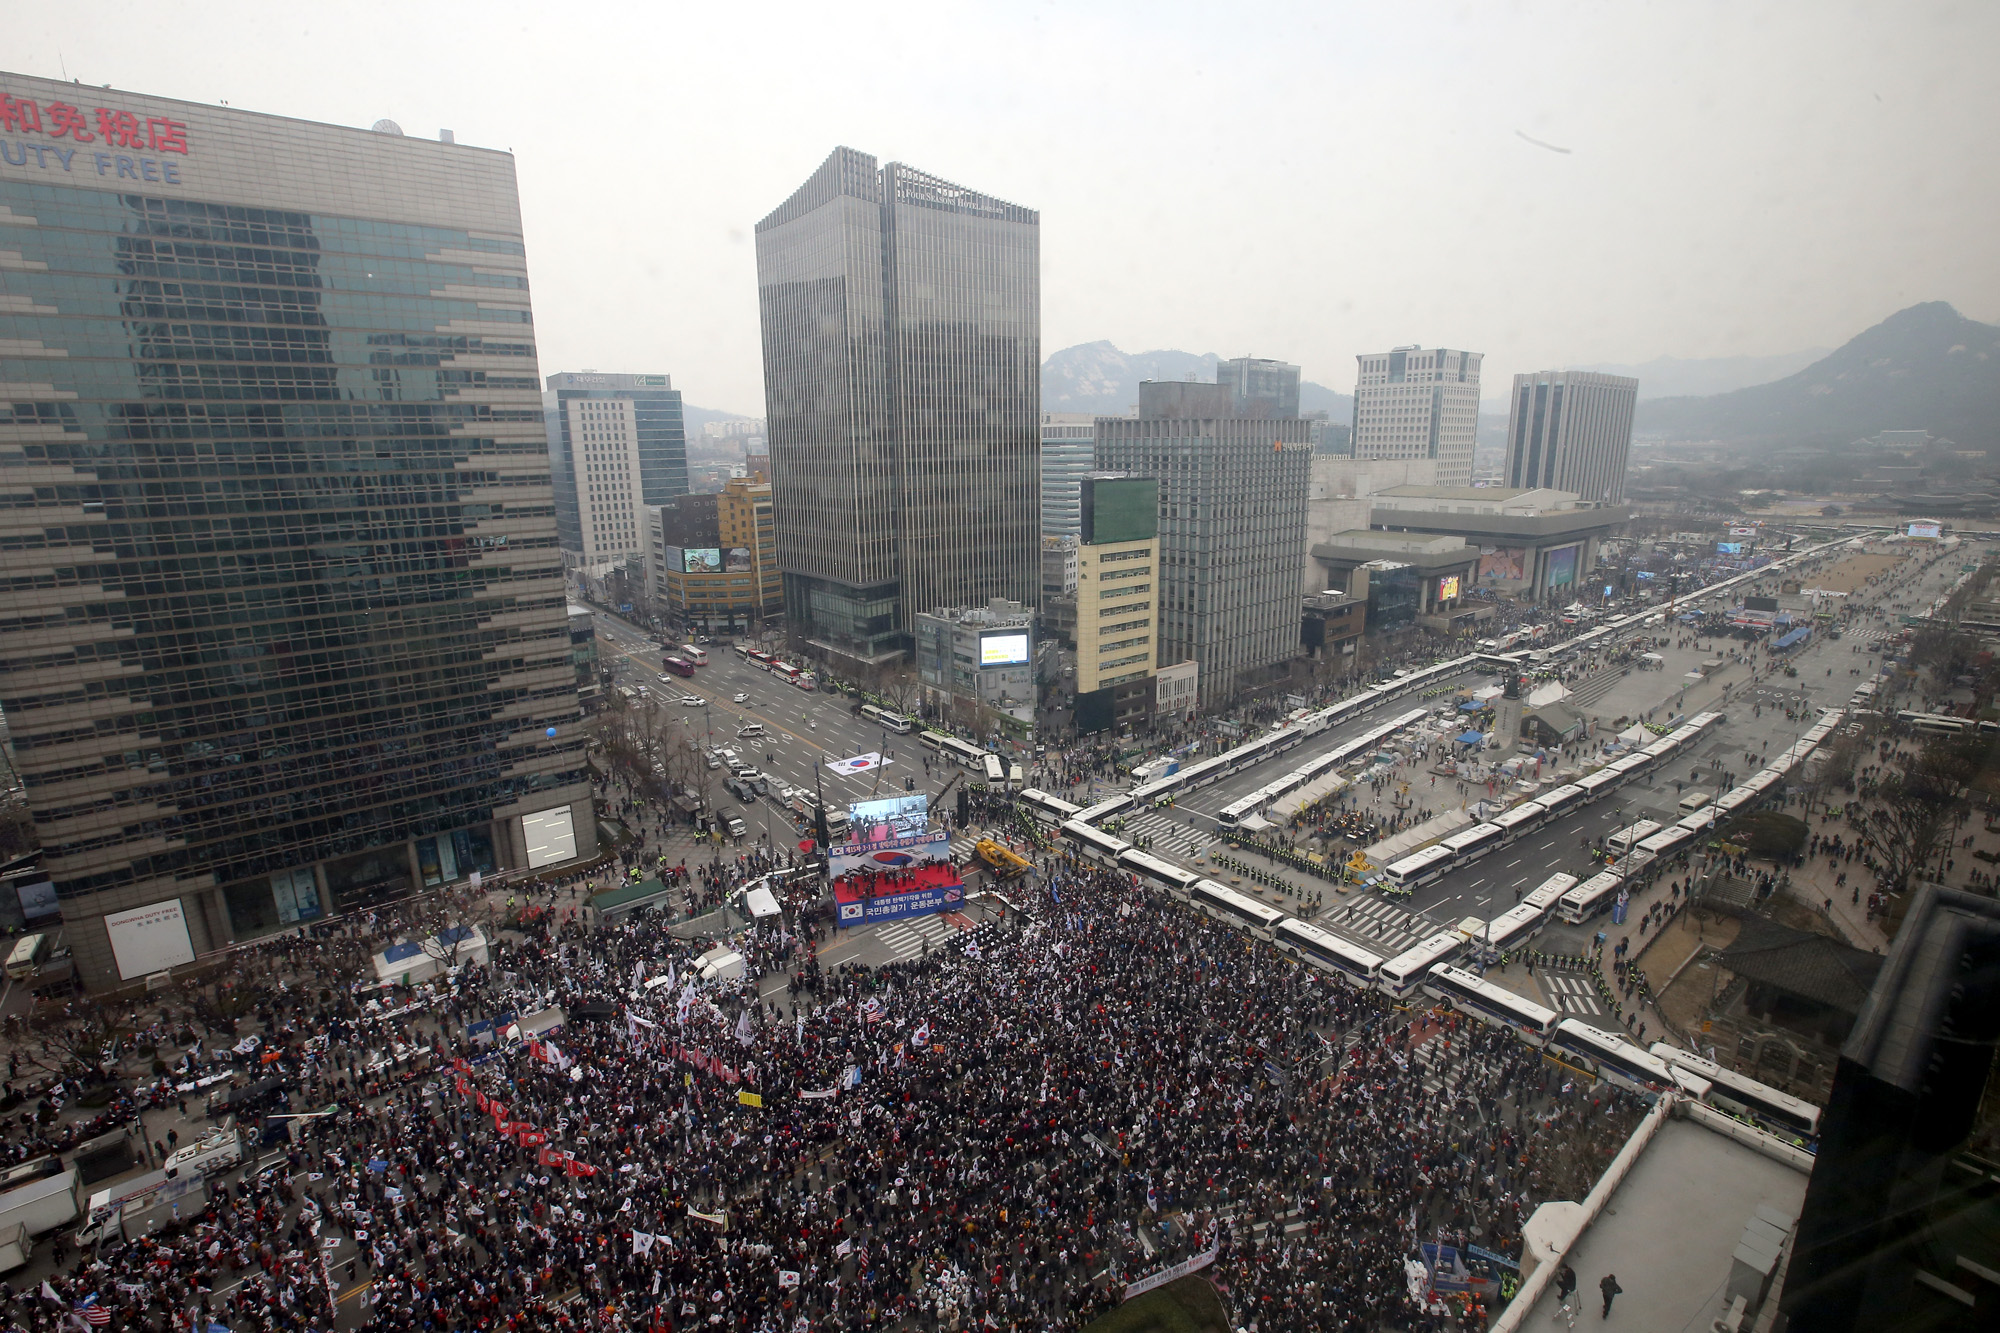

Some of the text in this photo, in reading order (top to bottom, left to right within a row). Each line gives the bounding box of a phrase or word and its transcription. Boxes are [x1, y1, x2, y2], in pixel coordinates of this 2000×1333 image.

[94, 151, 181, 184] FREE
[866, 898, 942, 917] 국민총궐기 운동본부
[874, 898, 891, 906] 대통령
[892, 894, 920, 904] 탄핵기각을
[111, 915, 144, 927] DONGWHA
[144, 910, 161, 919] DUTY
[161, 906, 178, 914] FREE
[194, 1150, 234, 1175] SBS
